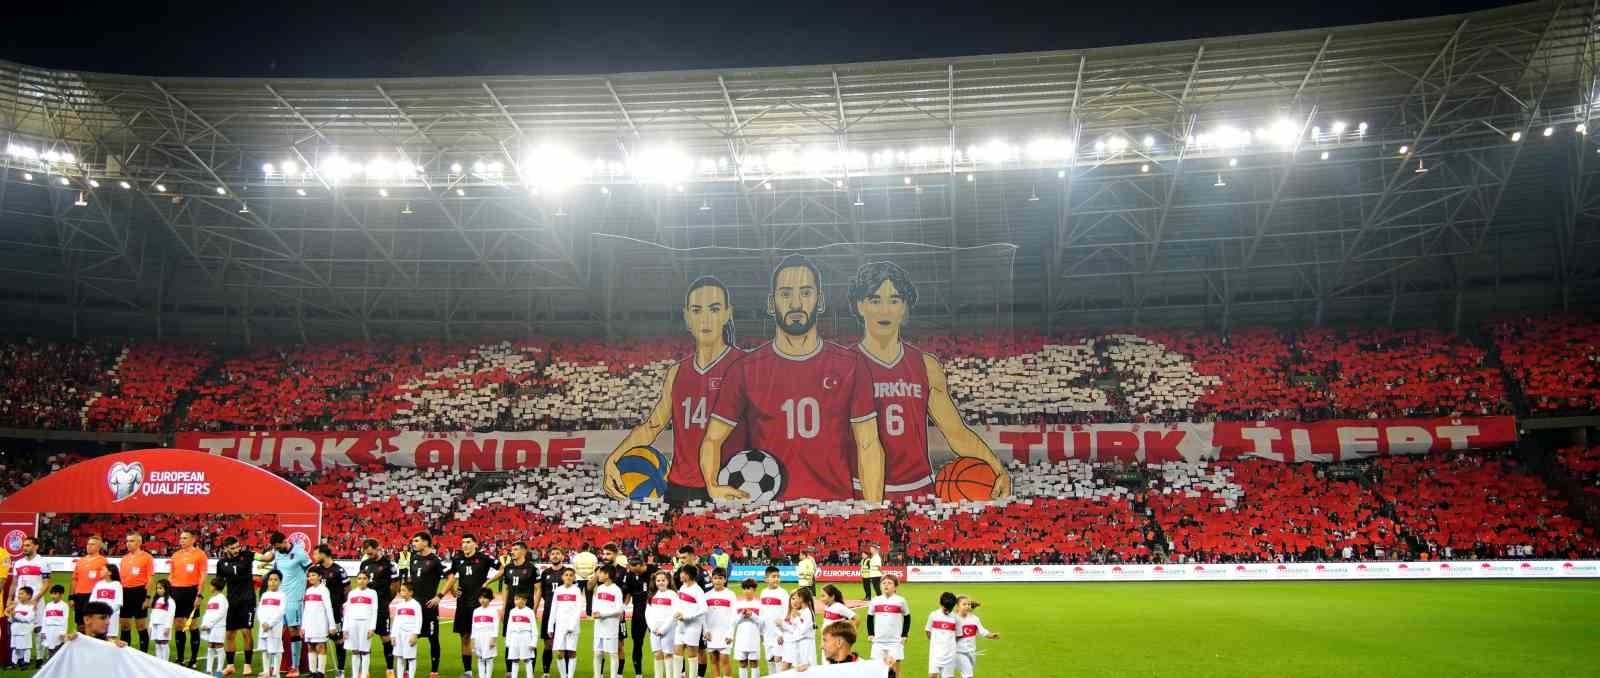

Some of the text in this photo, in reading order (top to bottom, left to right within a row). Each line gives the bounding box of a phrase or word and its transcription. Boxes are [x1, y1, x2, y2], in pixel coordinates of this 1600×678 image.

[874, 378, 922, 399] RKİYE
[681, 396, 708, 430] 14
[781, 396, 820, 439] 10
[886, 404, 905, 436] 6
[198, 432, 586, 472] TÜRK ÖNDE
[1000, 424, 1186, 464] TÜRK
[142, 482, 211, 497] QUALIFIERS
[150, 471, 205, 482] EUROPEAN
